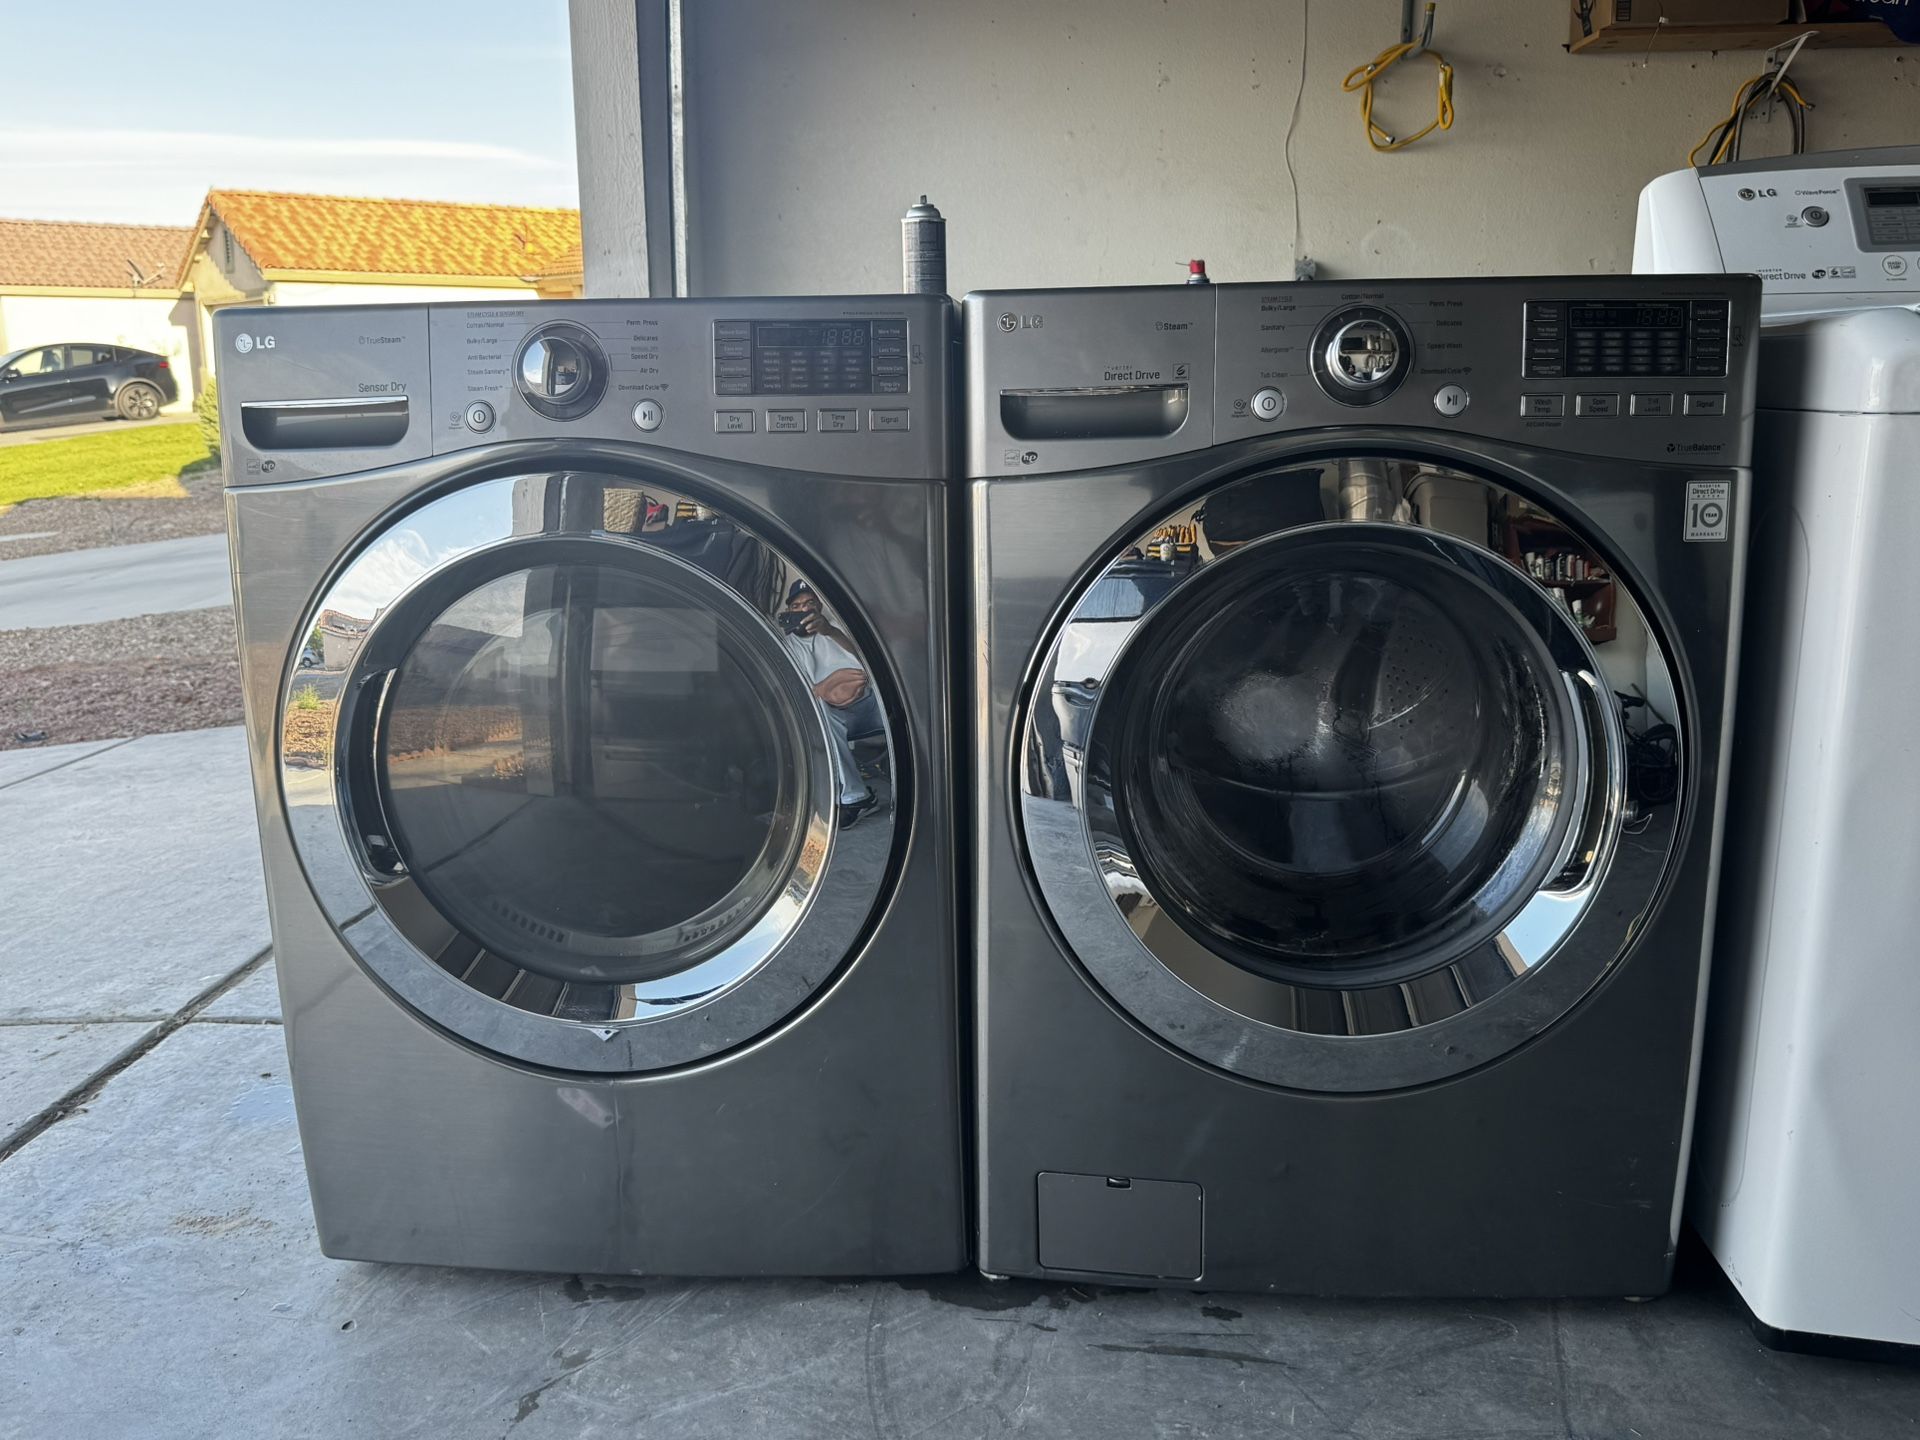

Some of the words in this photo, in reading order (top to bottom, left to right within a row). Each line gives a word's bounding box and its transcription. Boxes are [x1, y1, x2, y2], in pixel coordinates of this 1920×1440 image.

[1758, 188, 1778, 198] LG
[1784, 272, 1806, 280] Drive
[1021, 315, 1044, 329] LG
[256, 335, 276, 349] LG
[1104, 371, 1133, 381] Direct
[1135, 370, 1160, 380] Drive
[358, 382, 389, 393] Sensor
[391, 381, 407, 394] Dry
[1696, 400, 1715, 409] Signal
[729, 415, 741, 423] Dry
[880, 415, 899, 424] Signal
[727, 421, 744, 429] Level
[776, 421, 798, 429] Control
[833, 421, 844, 429] Dry
[1676, 443, 1721, 451] TrueBalance
[1691, 502, 1724, 528] 10
